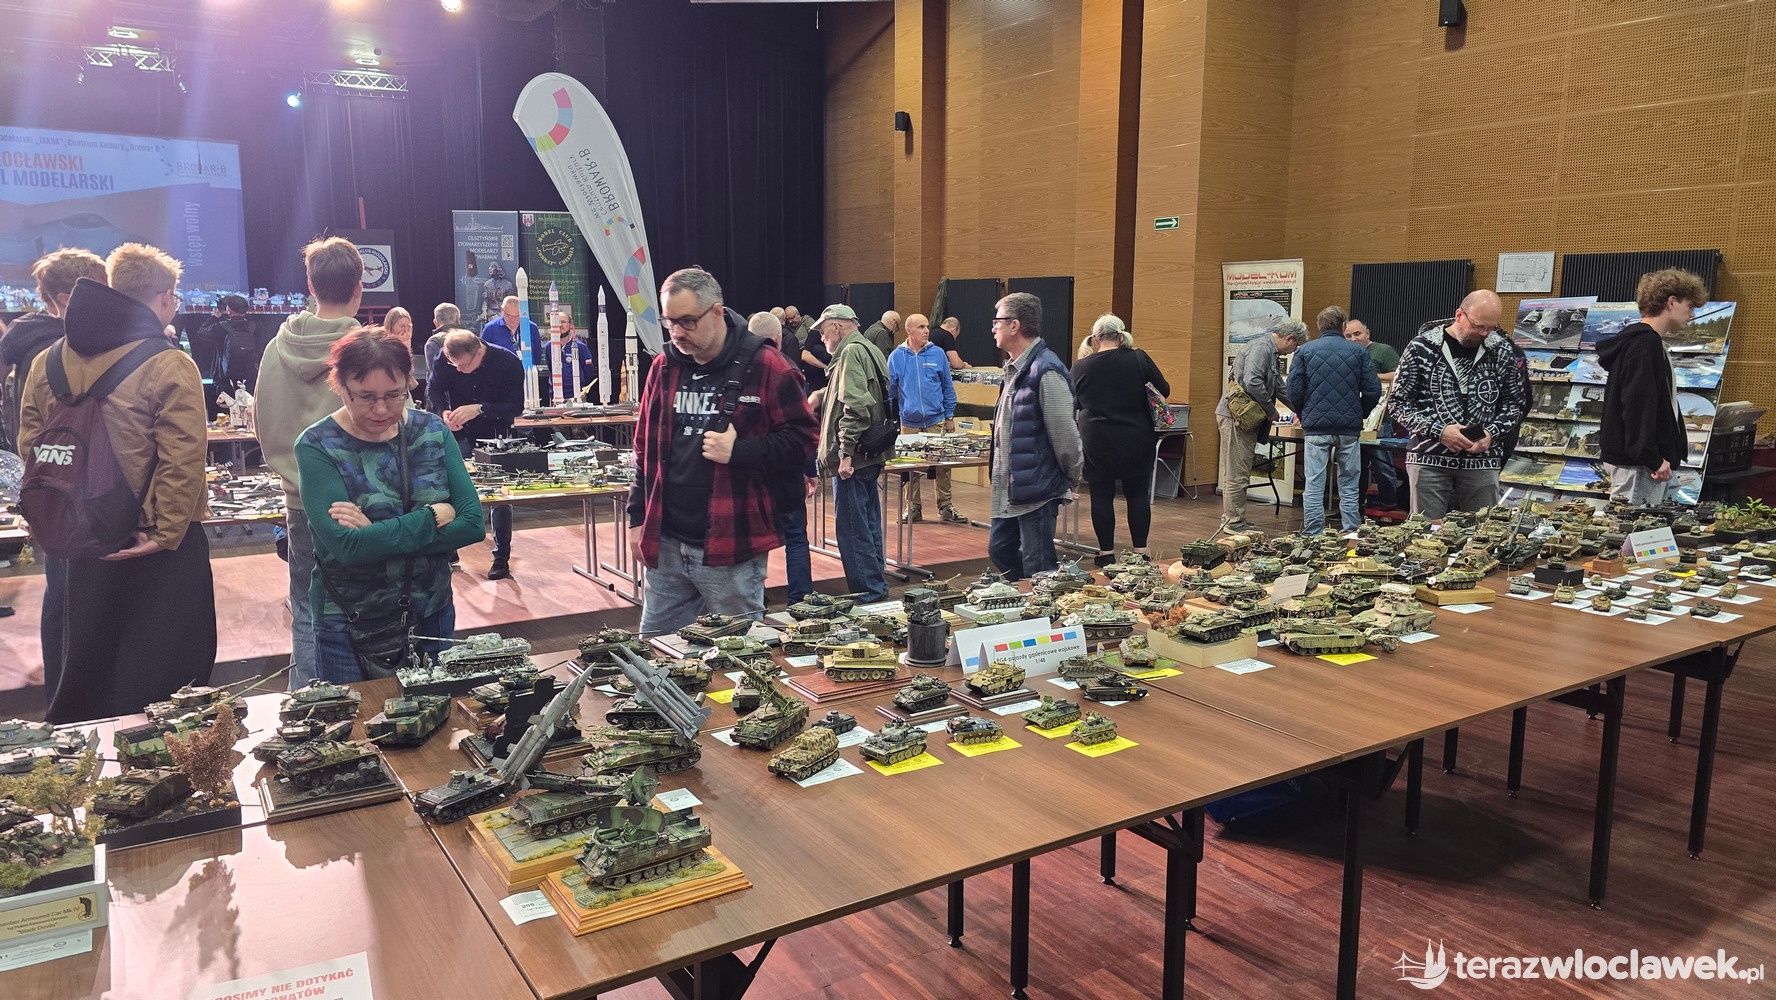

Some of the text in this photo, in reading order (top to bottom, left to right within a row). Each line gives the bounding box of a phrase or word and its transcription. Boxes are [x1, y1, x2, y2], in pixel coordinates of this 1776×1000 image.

[0, 151, 84, 171] OCŁAWSKI
[13, 170, 114, 191] MODELARSKI
[671, 391, 720, 415] ANKE
[33, 443, 76, 466] VANS
[271, 982, 292, 993] NIE
[296, 968, 354, 988] DOTYKAĆ
